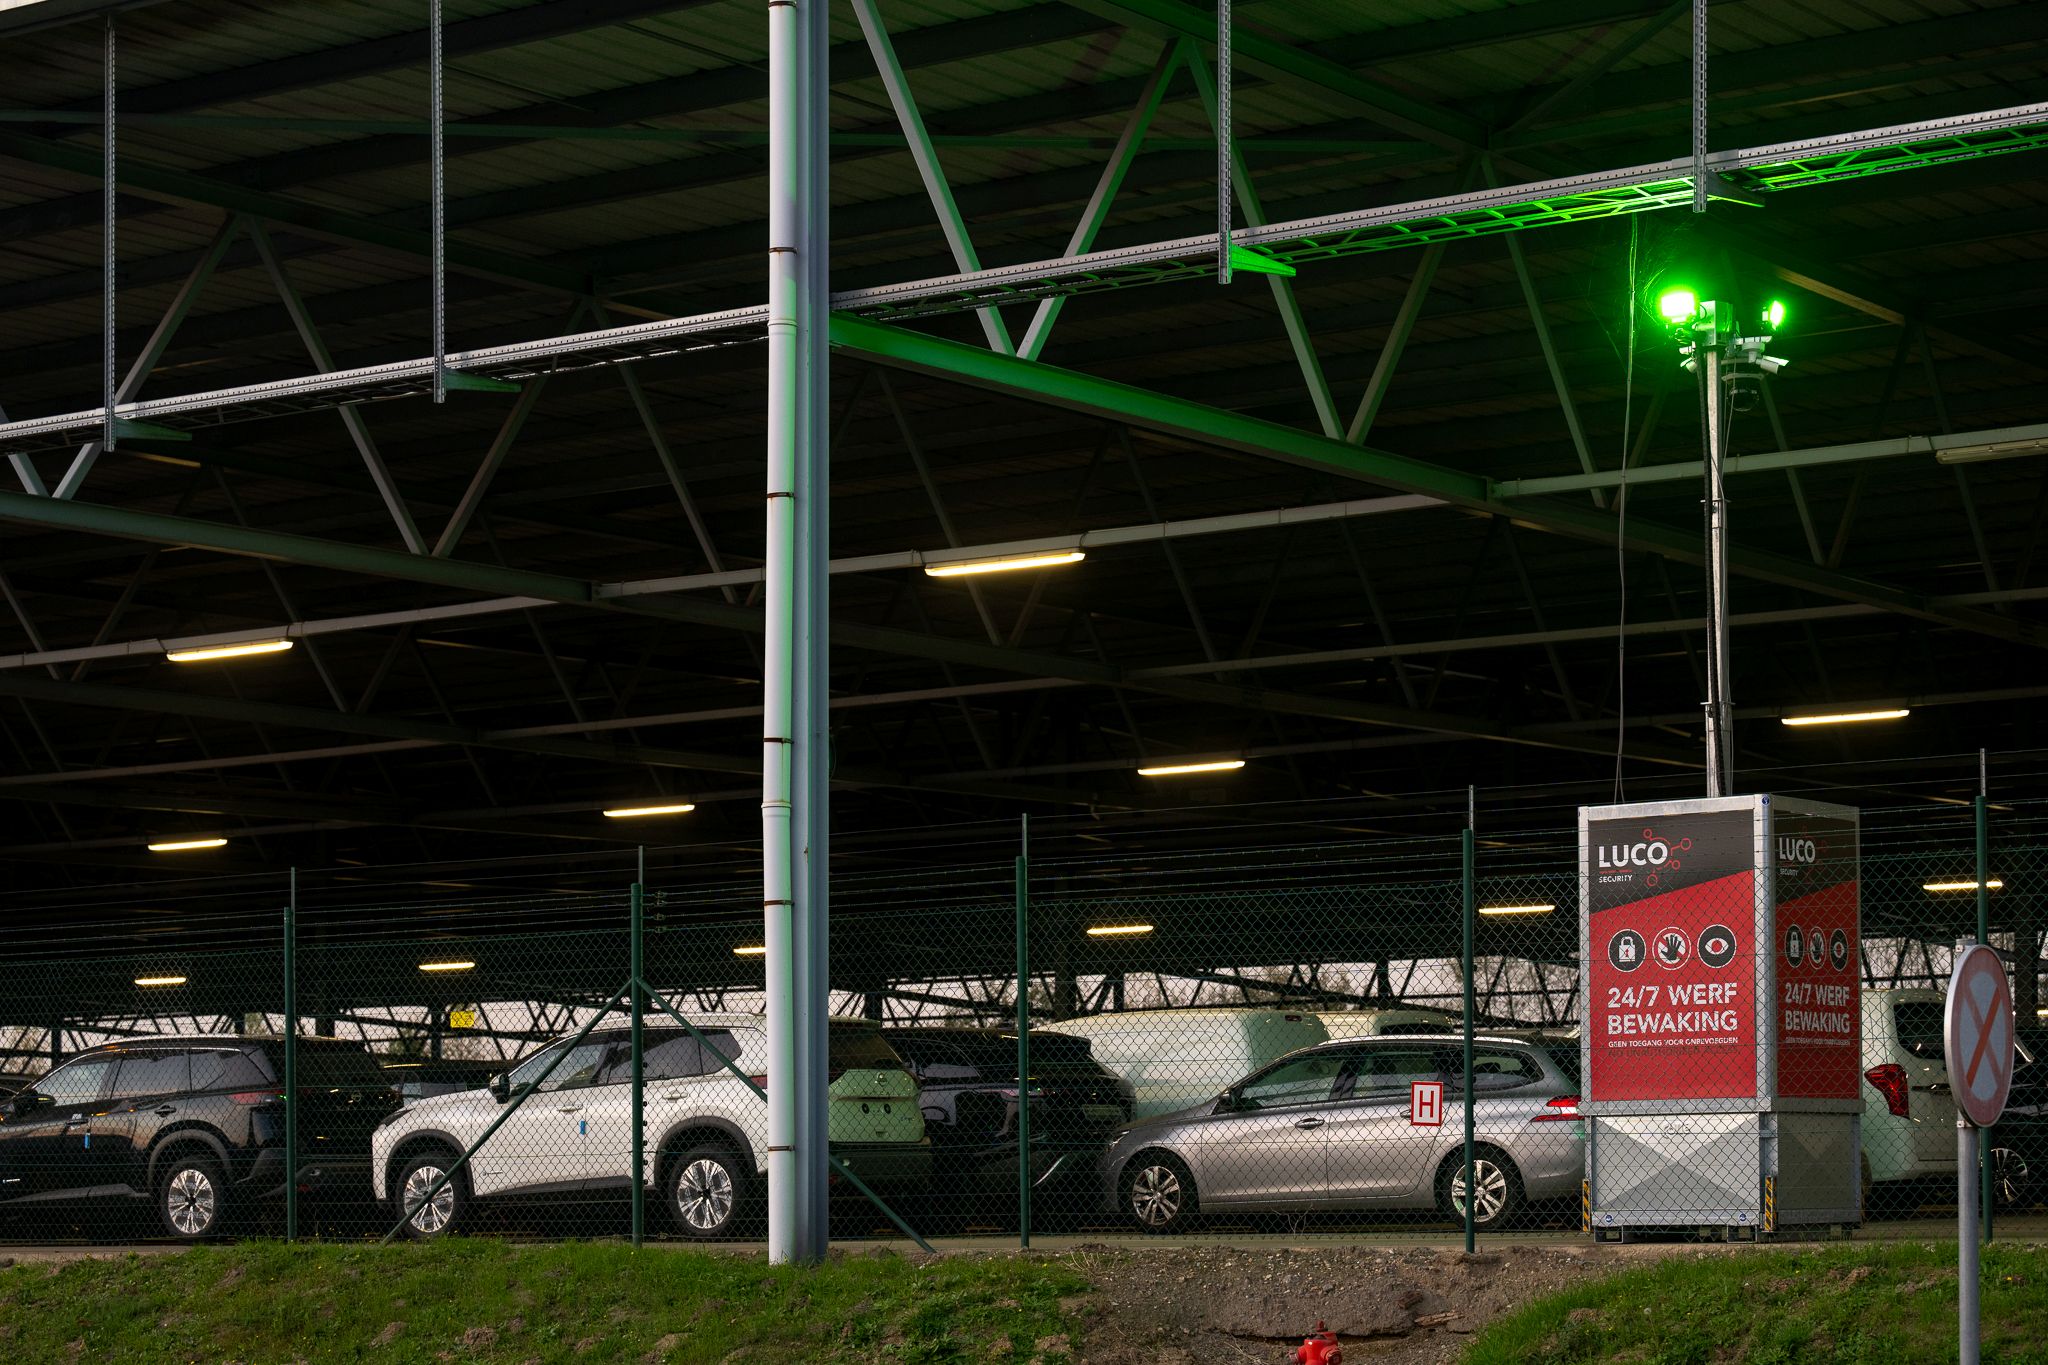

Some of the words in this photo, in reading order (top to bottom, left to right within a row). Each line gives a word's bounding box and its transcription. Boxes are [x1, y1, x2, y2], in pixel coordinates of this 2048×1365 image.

[1598, 842, 1668, 868] LUCO
[1779, 837, 1816, 863] LUCO
[1598, 874, 1633, 884] SECURITY
[1607, 985, 1660, 1008] 24/7
[1667, 982, 1738, 1006] WERF
[1785, 982, 1812, 1005] 24/7
[1815, 984, 1850, 1007] WERF
[1607, 1009, 1738, 1035] BEWAKING
[1785, 1009, 1850, 1034] BEWAKING
[1608, 1040, 1628, 1048] GEEN
[1629, 1039, 1663, 1047] TOEGANG
[1418, 1090, 1435, 1118] H
